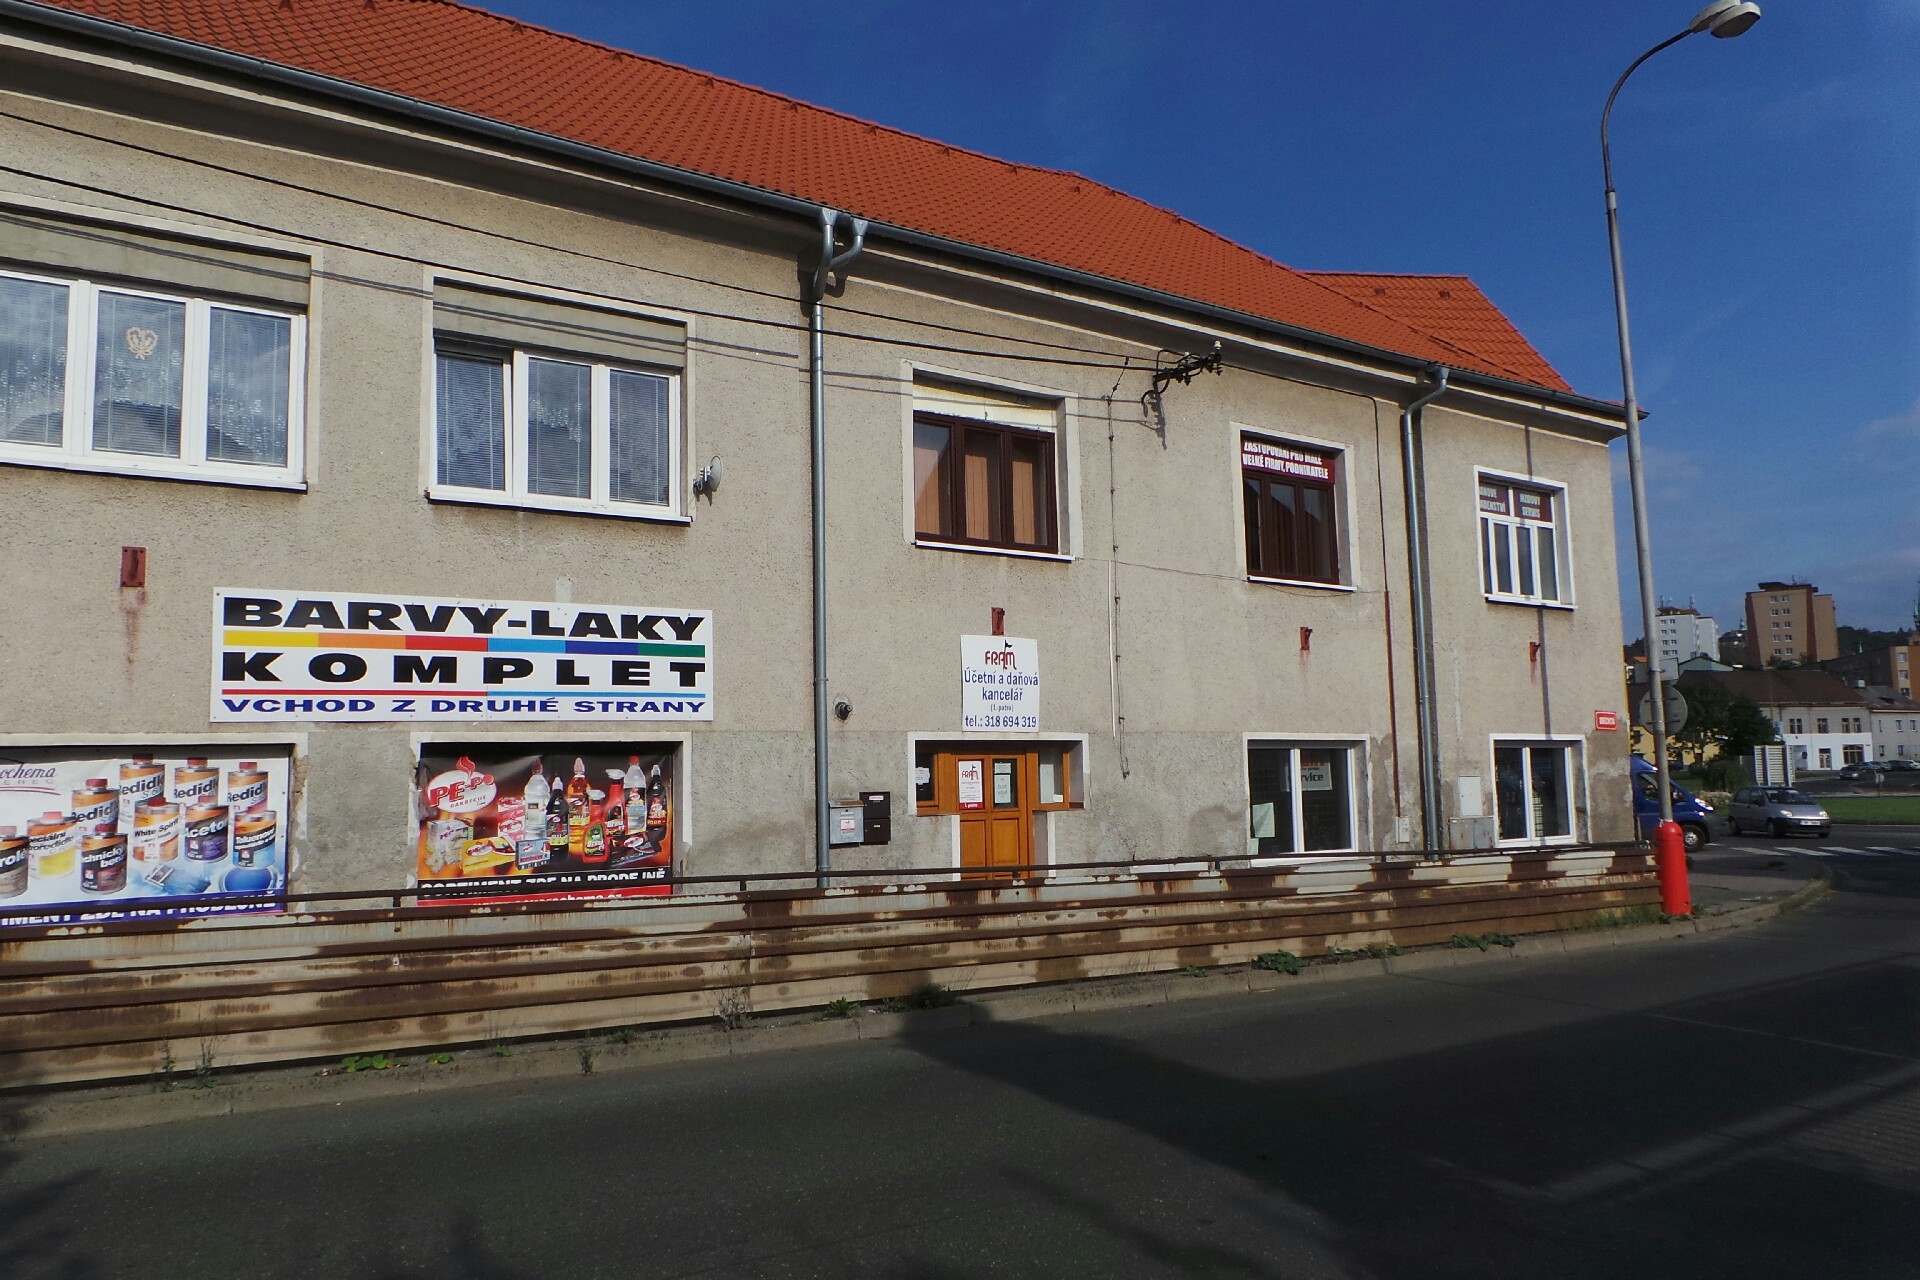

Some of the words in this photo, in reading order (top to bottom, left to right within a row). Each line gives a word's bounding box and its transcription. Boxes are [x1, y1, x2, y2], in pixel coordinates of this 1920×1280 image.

[1242, 453, 1264, 468] VELKÉ
[223, 597, 705, 641] BARVY-LAKY
[222, 651, 706, 687] KOMPLET
[985, 650, 1017, 671] FRAM
[964, 667, 996, 684] Účetní
[998, 675, 1004, 685] a
[1006, 672, 1039, 686] daňová
[982, 687, 1023, 701] kancelář
[222, 699, 375, 713] VCHOD
[391, 700, 416, 713] Z
[431, 697, 559, 713] DRUHÉ
[573, 701, 706, 713] STRANY
[965, 715, 983, 727] tel.:
[984, 715, 1001, 727] 318
[1002, 716, 1019, 727] 694
[1021, 716, 1037, 728] 319
